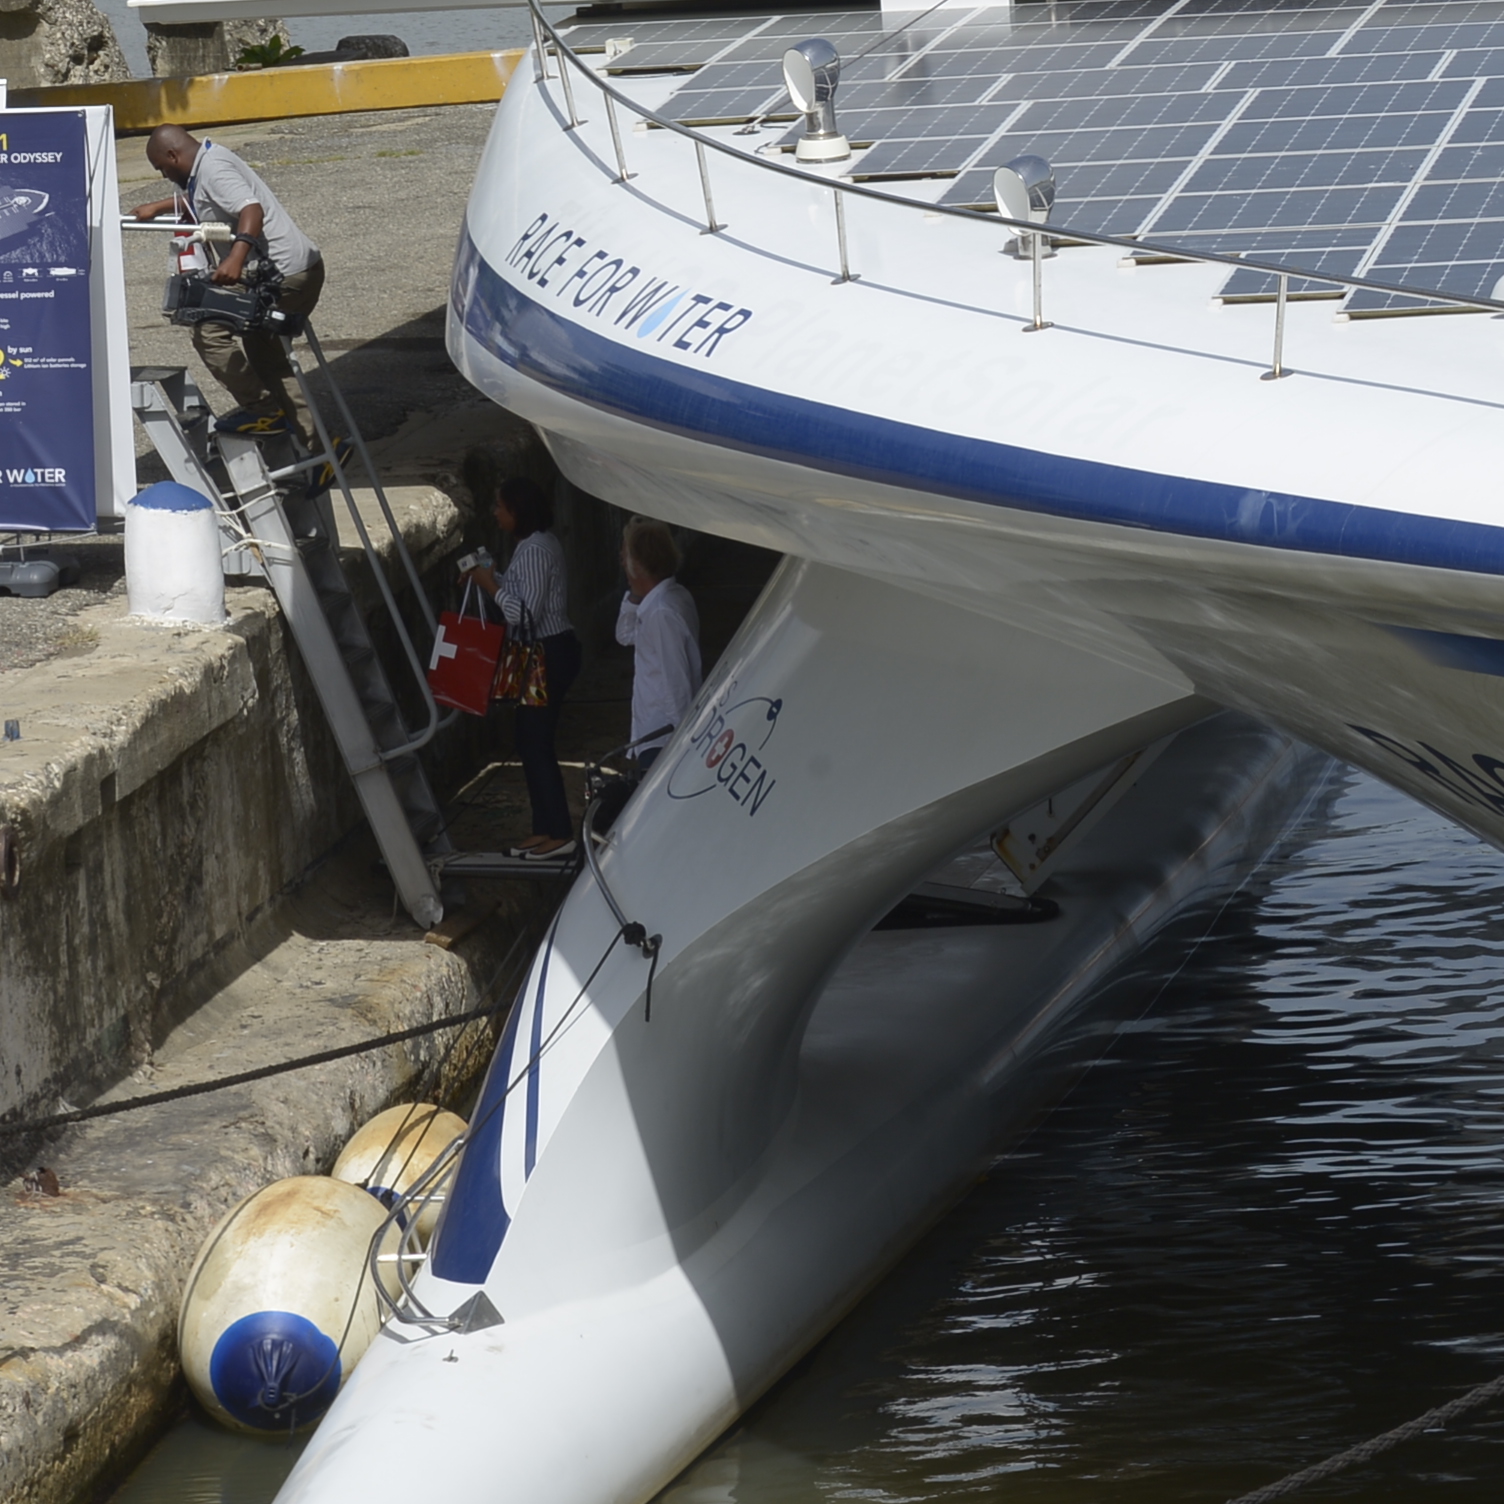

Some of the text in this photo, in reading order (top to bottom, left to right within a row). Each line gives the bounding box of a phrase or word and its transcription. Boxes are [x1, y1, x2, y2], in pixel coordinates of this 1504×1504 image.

[11, 152, 63, 164] ODYSSEY
[504, 212, 586, 288] RACE
[556, 249, 641, 317] FOR
[20, 290, 55, 300] powered
[7, 346, 18, 355] by
